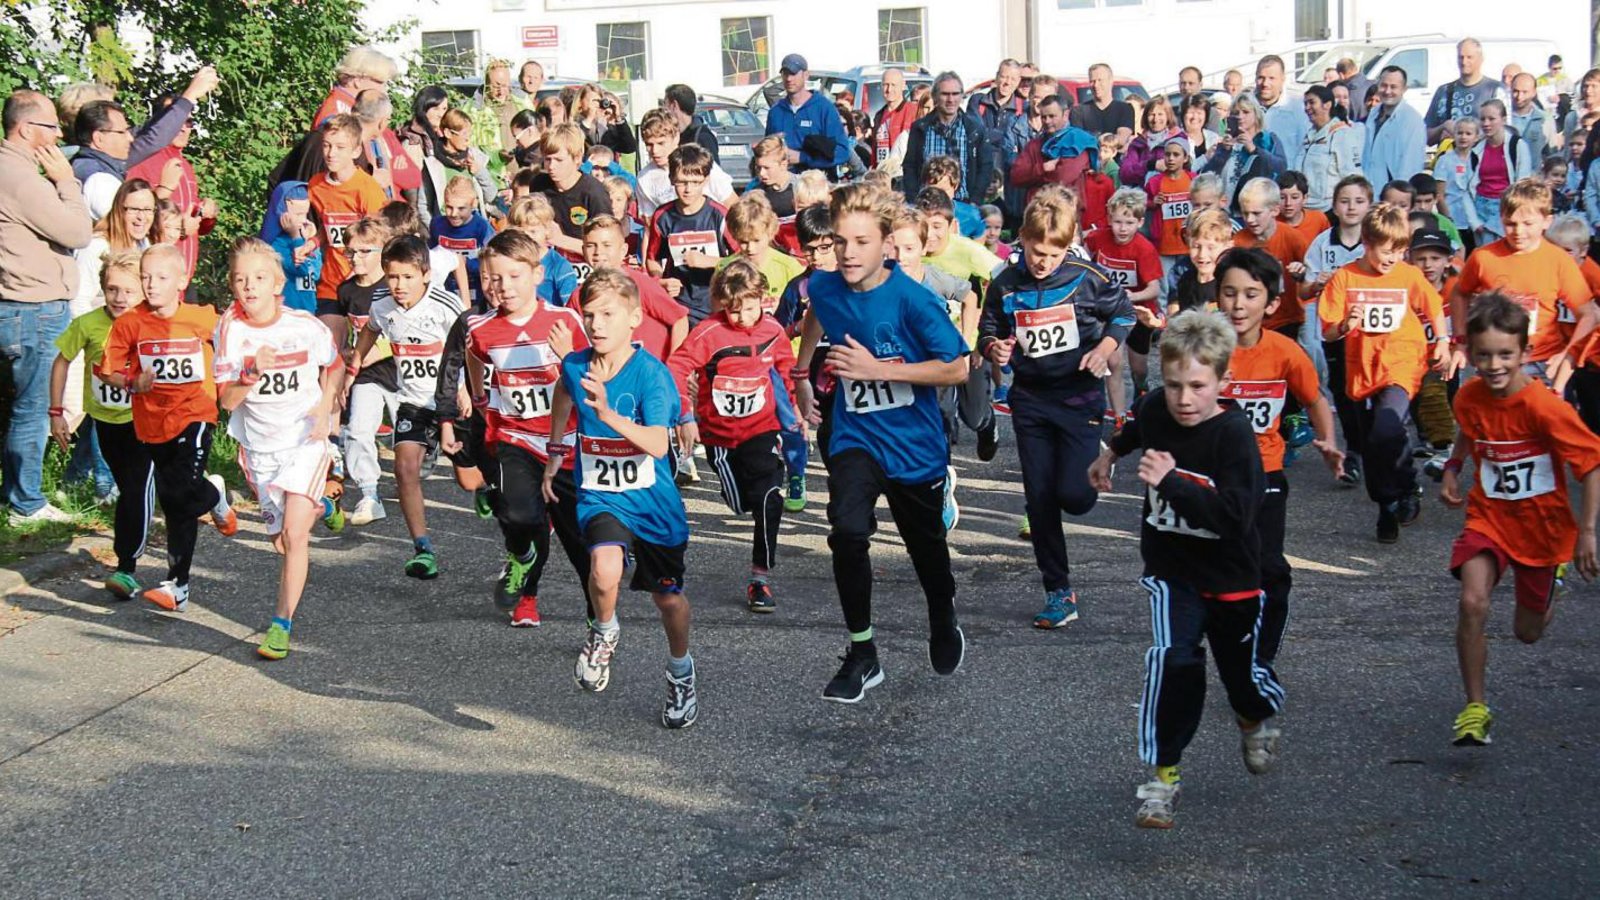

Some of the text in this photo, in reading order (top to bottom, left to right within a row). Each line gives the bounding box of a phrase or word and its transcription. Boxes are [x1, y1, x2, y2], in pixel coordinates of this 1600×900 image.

[1168, 203, 1190, 217] 158
[1325, 250, 1336, 264] 13
[1361, 307, 1393, 328] 65
[1026, 325, 1068, 353] 292
[152, 358, 193, 380] 236
[401, 359, 438, 380] 286
[258, 370, 299, 395] 284
[512, 387, 550, 414] 311
[723, 393, 756, 415] 317
[851, 380, 895, 409] 211
[595, 458, 638, 487] 210
[1492, 461, 1536, 494] 257
